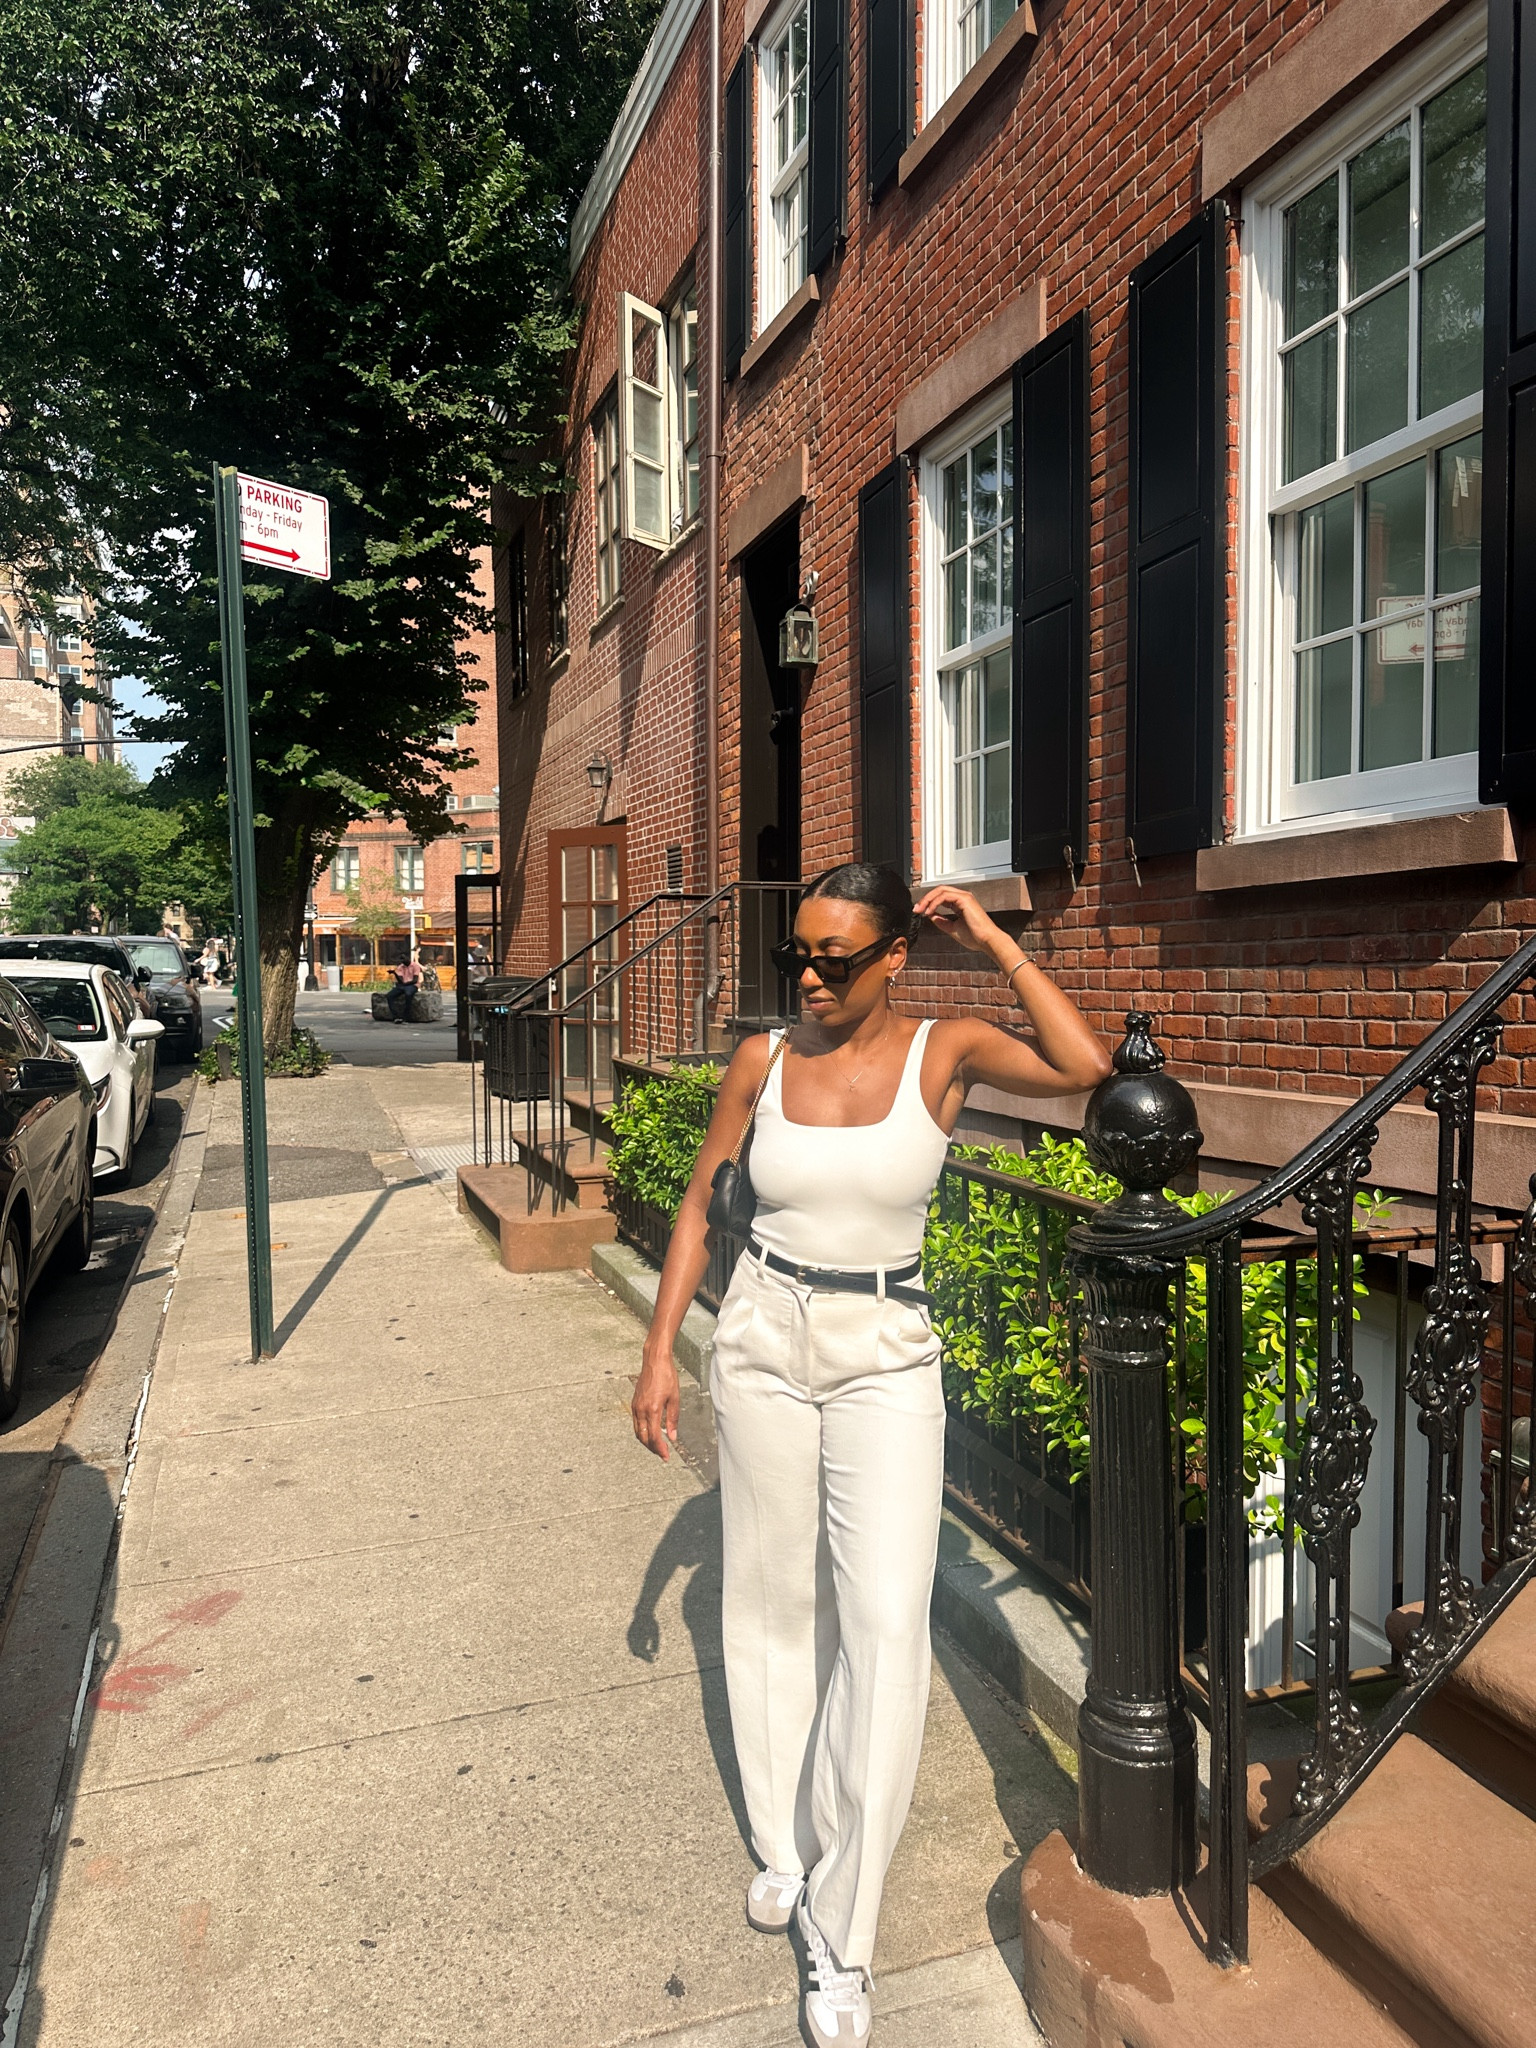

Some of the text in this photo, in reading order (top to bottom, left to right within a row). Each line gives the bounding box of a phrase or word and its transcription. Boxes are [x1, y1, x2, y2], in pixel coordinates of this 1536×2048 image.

[247, 485, 302, 513] PARKING
[240, 505, 263, 521] nday
[274, 512, 302, 532] Friday
[258, 523, 278, 539] 6pm
